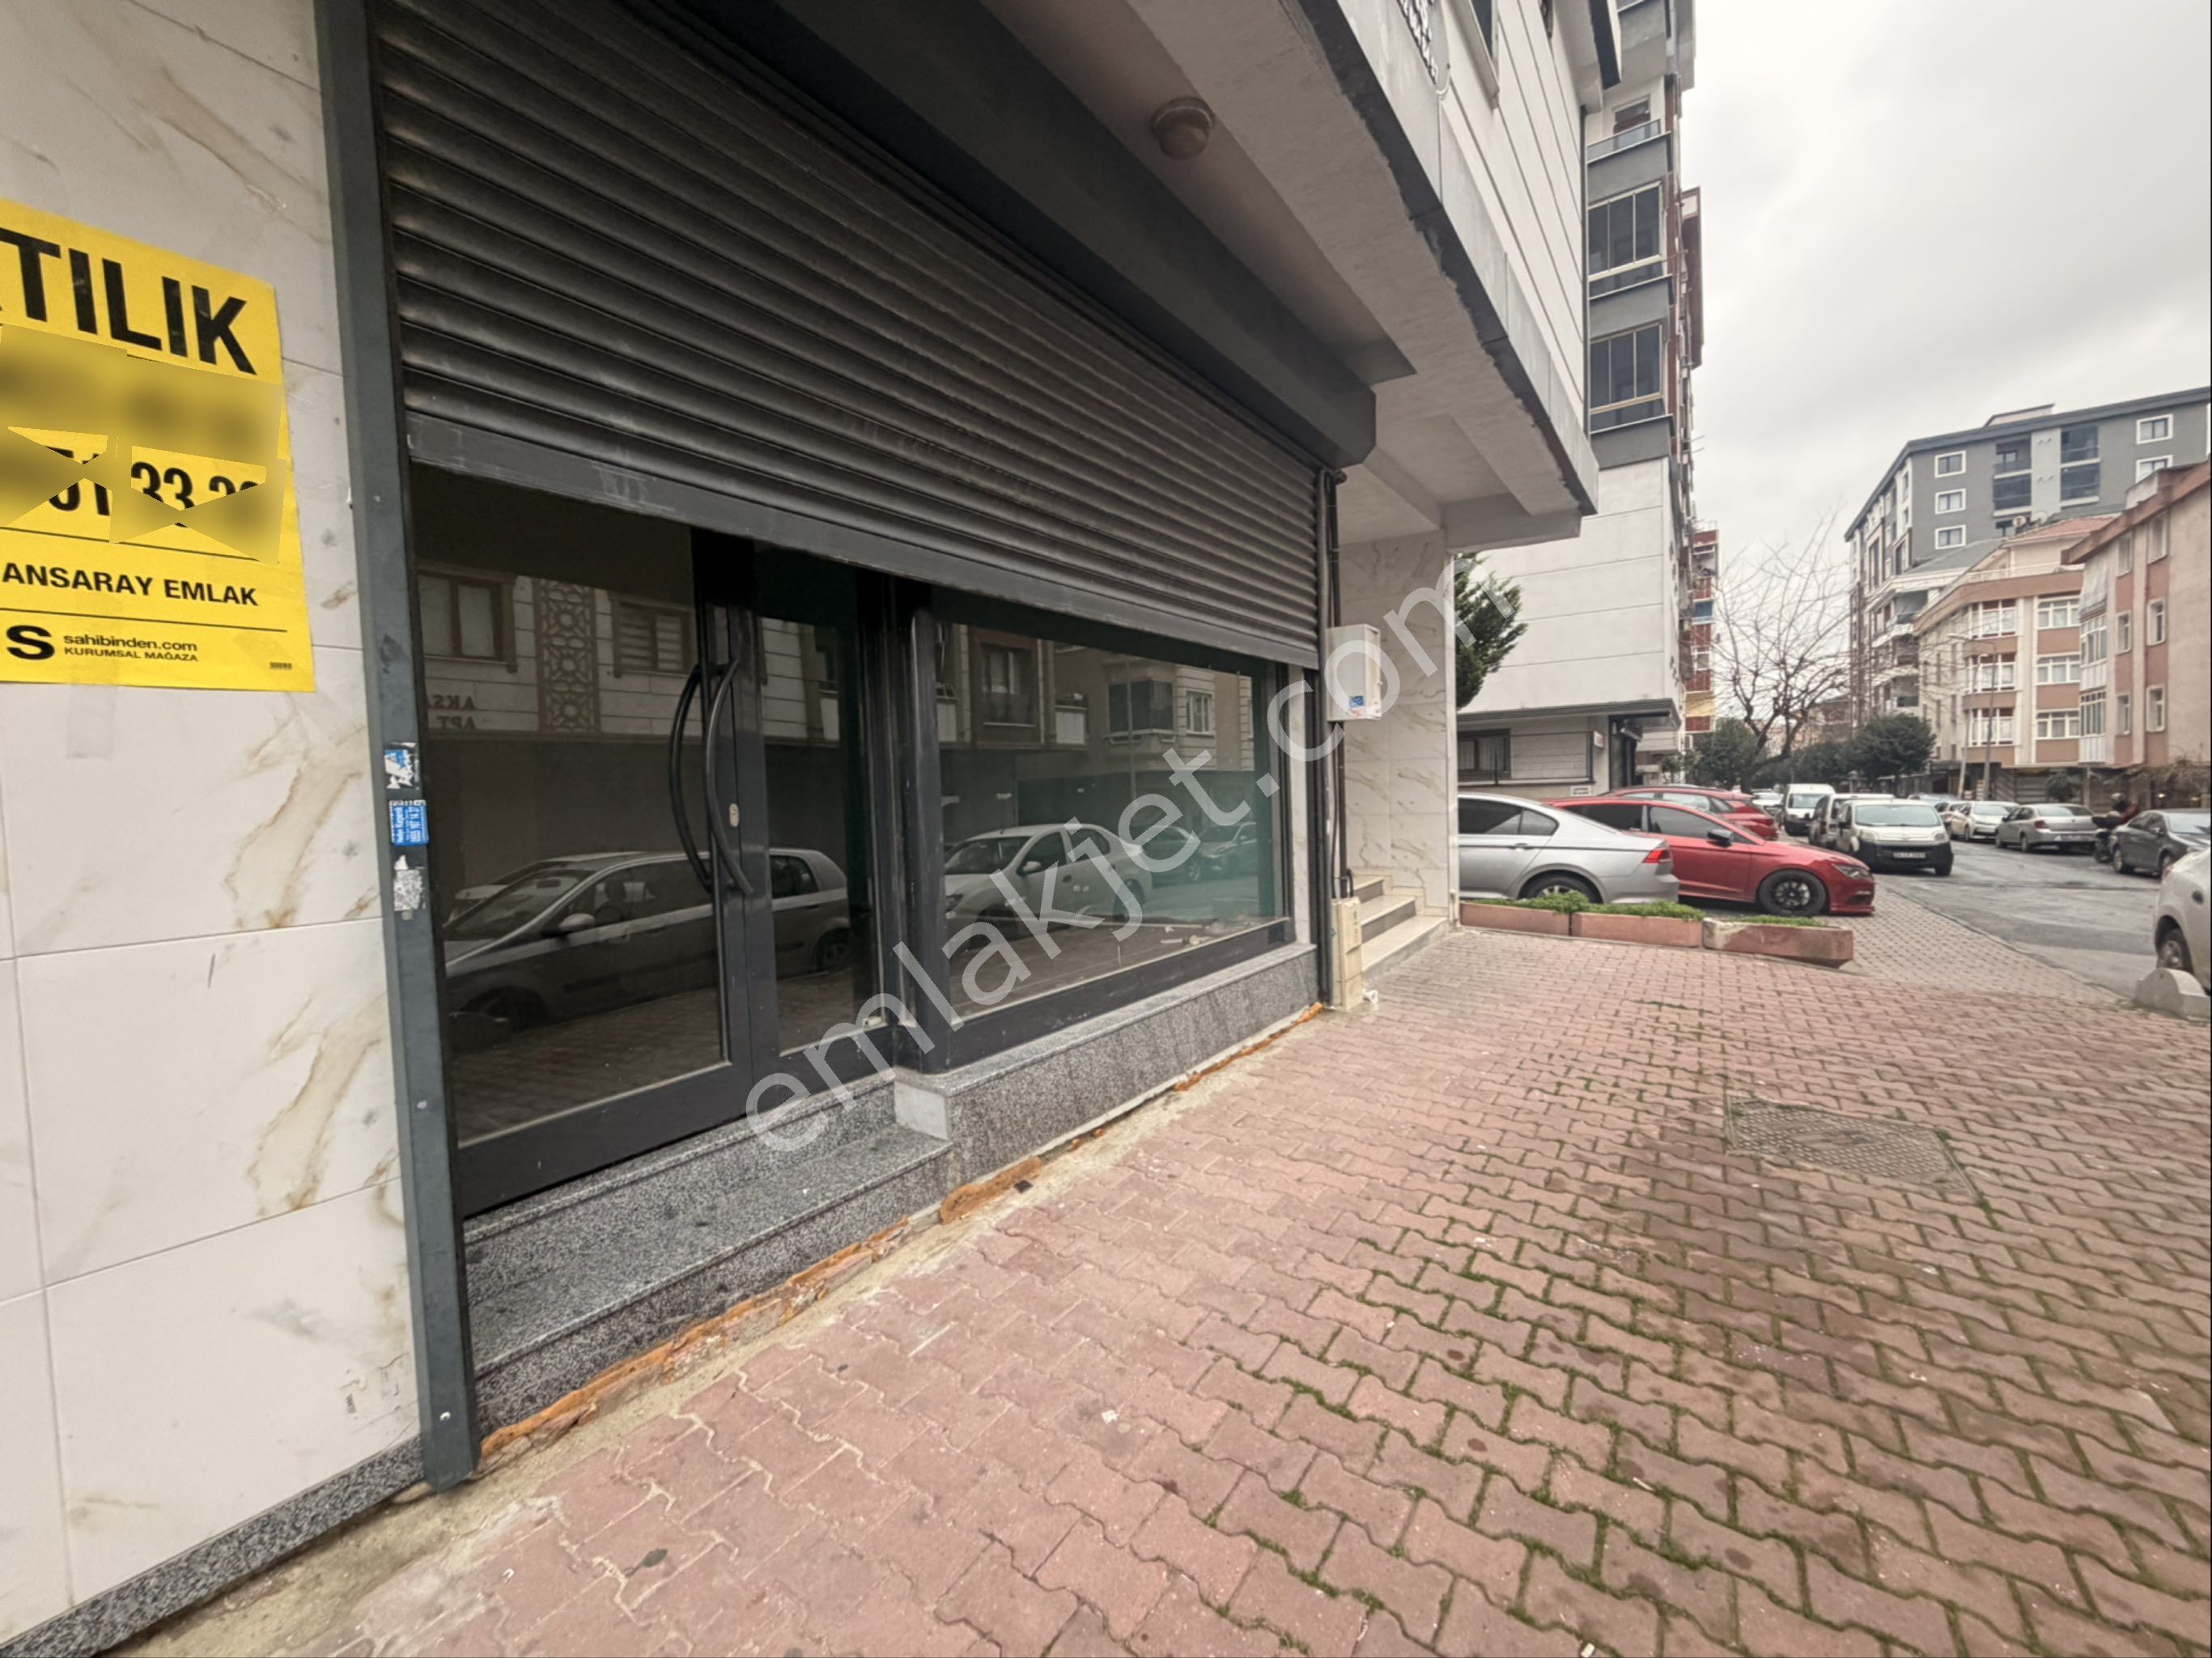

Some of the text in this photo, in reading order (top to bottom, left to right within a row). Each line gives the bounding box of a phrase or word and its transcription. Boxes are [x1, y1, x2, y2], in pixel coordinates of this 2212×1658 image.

[0, 227, 257, 375] TILIK
[164, 579, 258, 606] EMLAK
[6, 625, 197, 660] S sahibinden.com
[65, 647, 198, 662] KURUMSAL MAĞAZA
